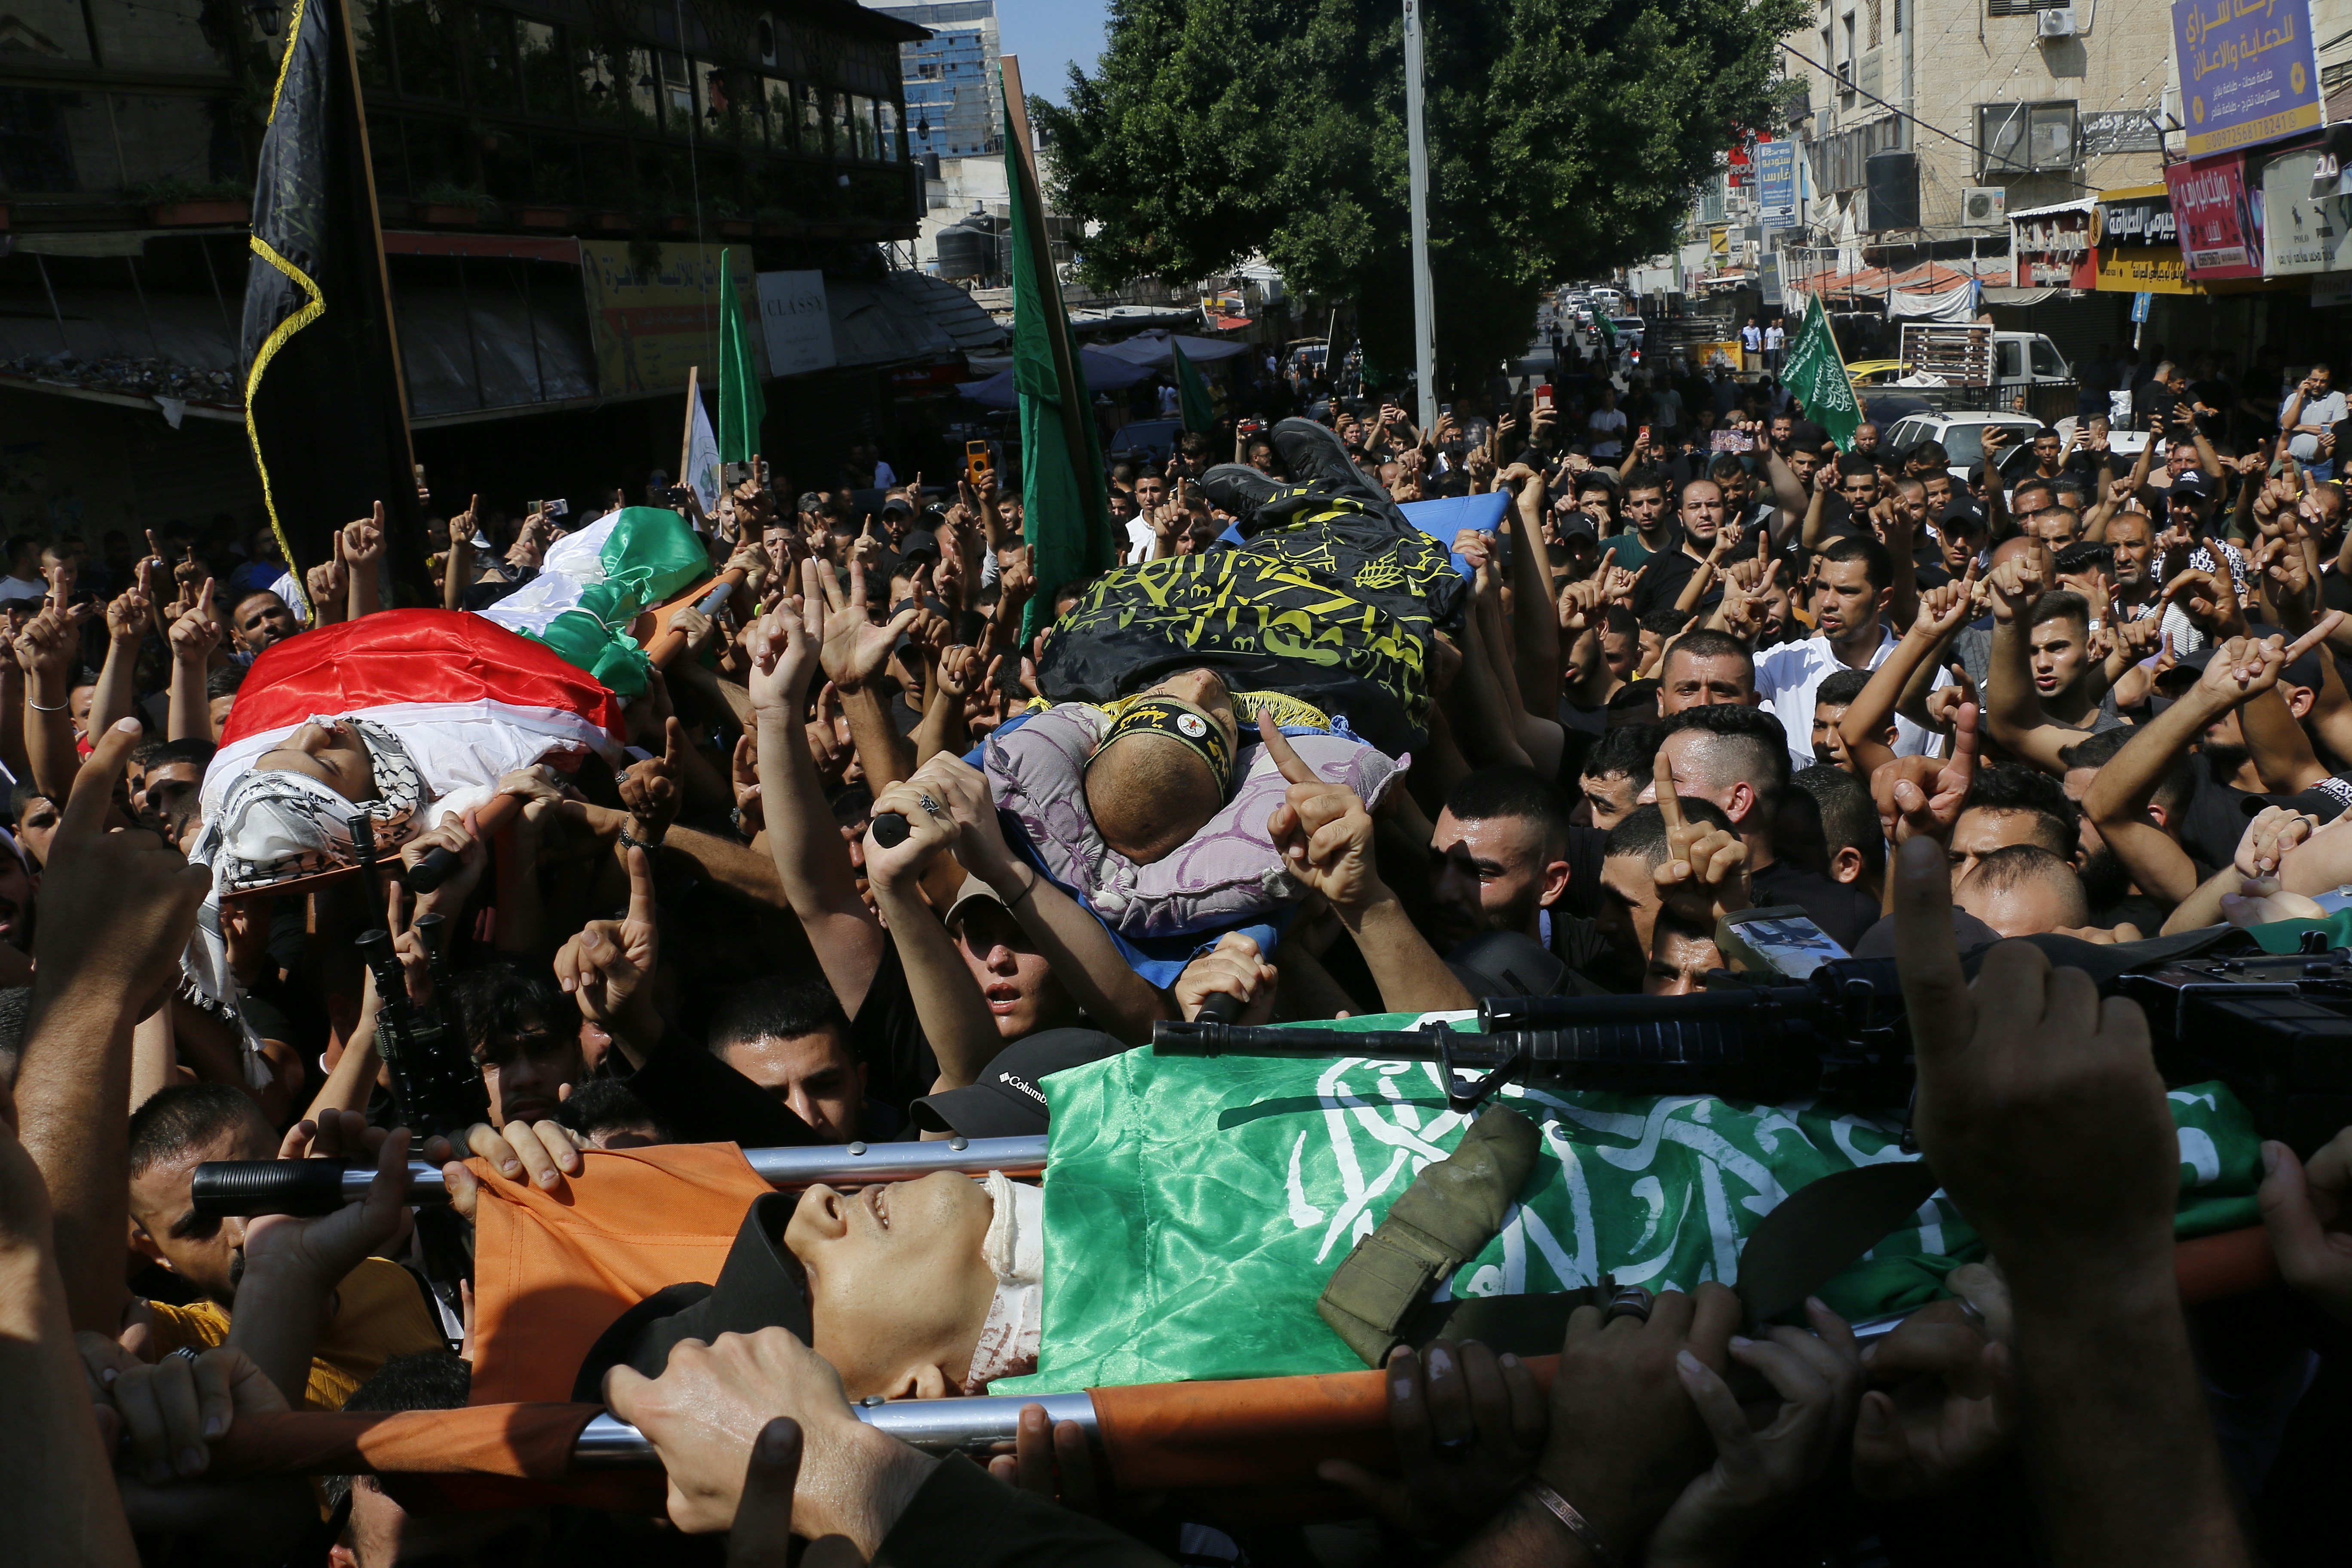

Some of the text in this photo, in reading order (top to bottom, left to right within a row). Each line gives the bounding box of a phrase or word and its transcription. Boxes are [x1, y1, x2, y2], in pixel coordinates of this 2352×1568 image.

[2241, 14, 2294, 62] للدعاية
[2257, 68, 2272, 84] طباعة
[2223, 80, 2238, 94] طباعة
[1730, 163, 1755, 174] ROU
[1762, 156, 1791, 168] ستوديو
[1763, 167, 1791, 183] فارس
[2294, 235, 2309, 243] POLO
[767, 294, 823, 317] CLASSY
[1114, 705, 1170, 736] كتيبة
[2319, 787, 2349, 806] DIVISIO
